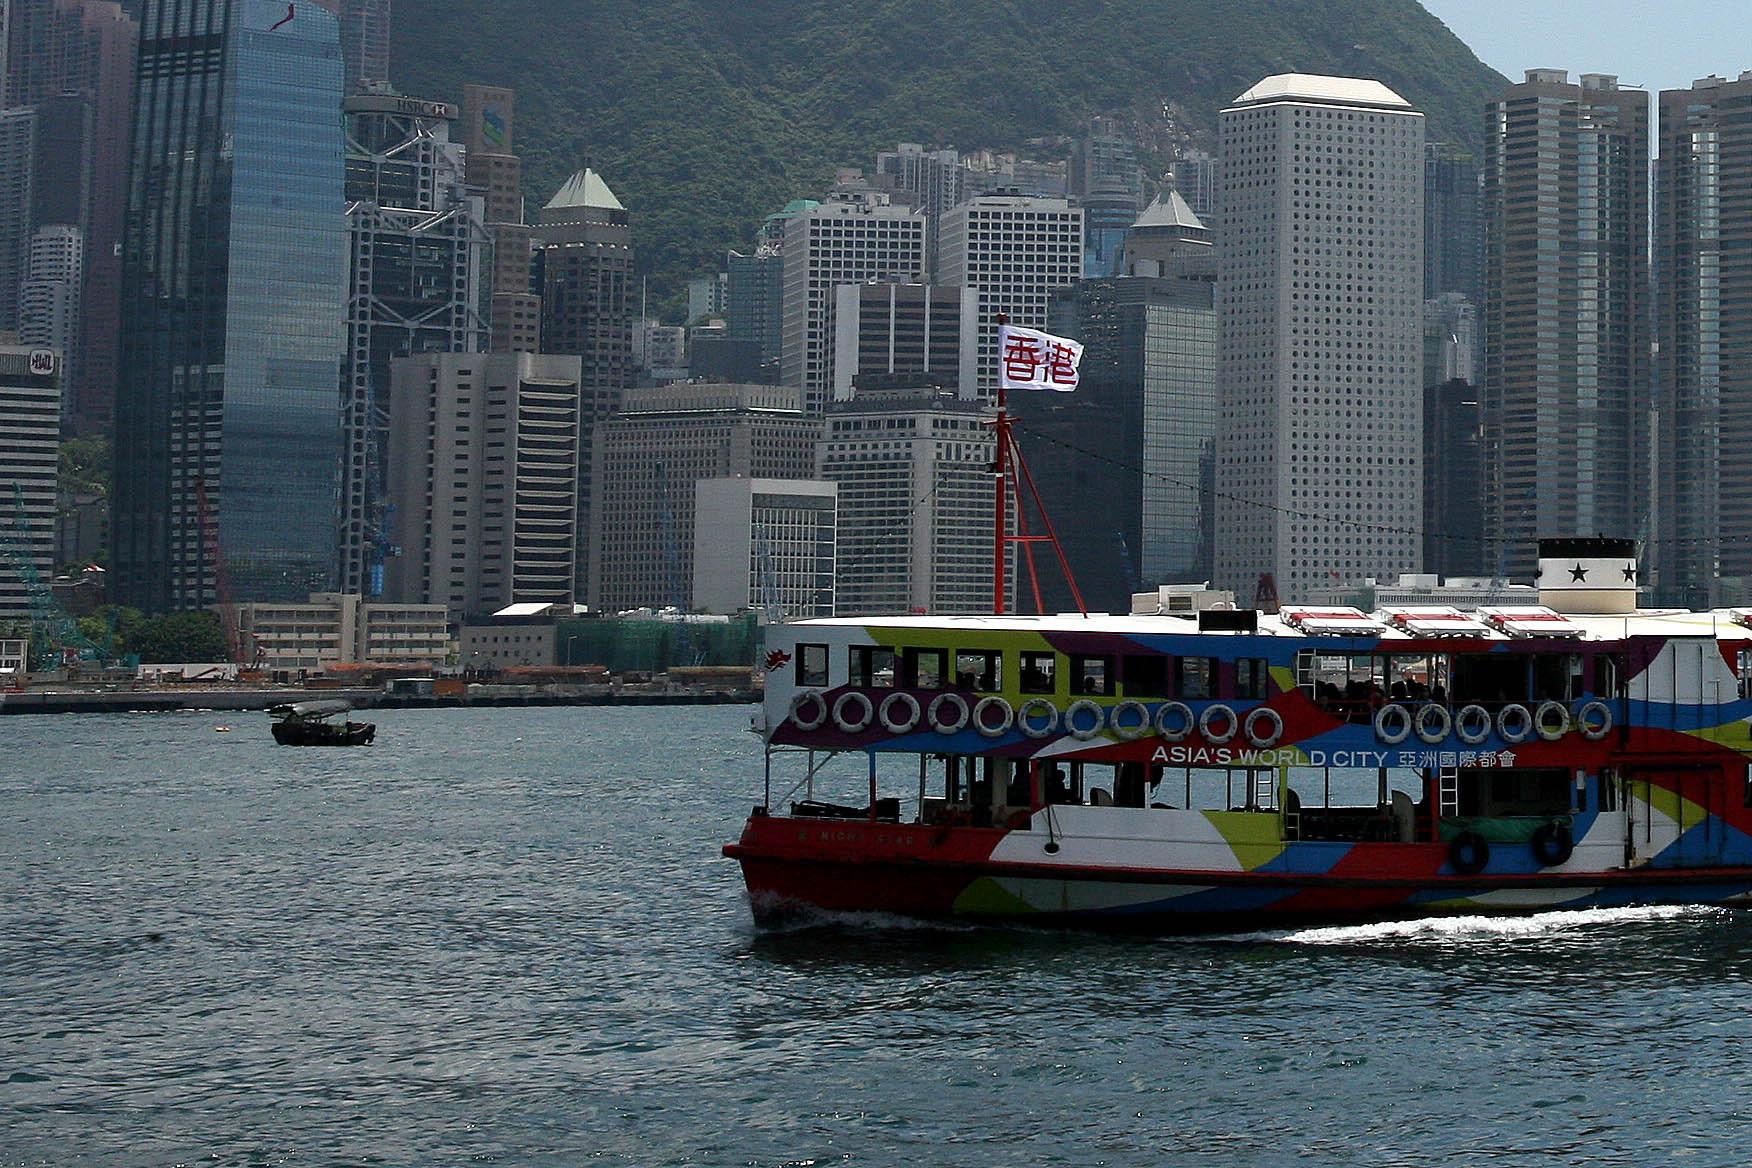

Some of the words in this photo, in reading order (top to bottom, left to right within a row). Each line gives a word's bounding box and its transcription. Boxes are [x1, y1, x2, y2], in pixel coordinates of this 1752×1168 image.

[1003, 335, 1076, 385] 香港
[1151, 745, 1232, 765] ASIA'S
[1238, 748, 1327, 766] WORLD
[1332, 750, 1389, 767] CITY
[1399, 750, 1516, 768] 亞洲國際都會
